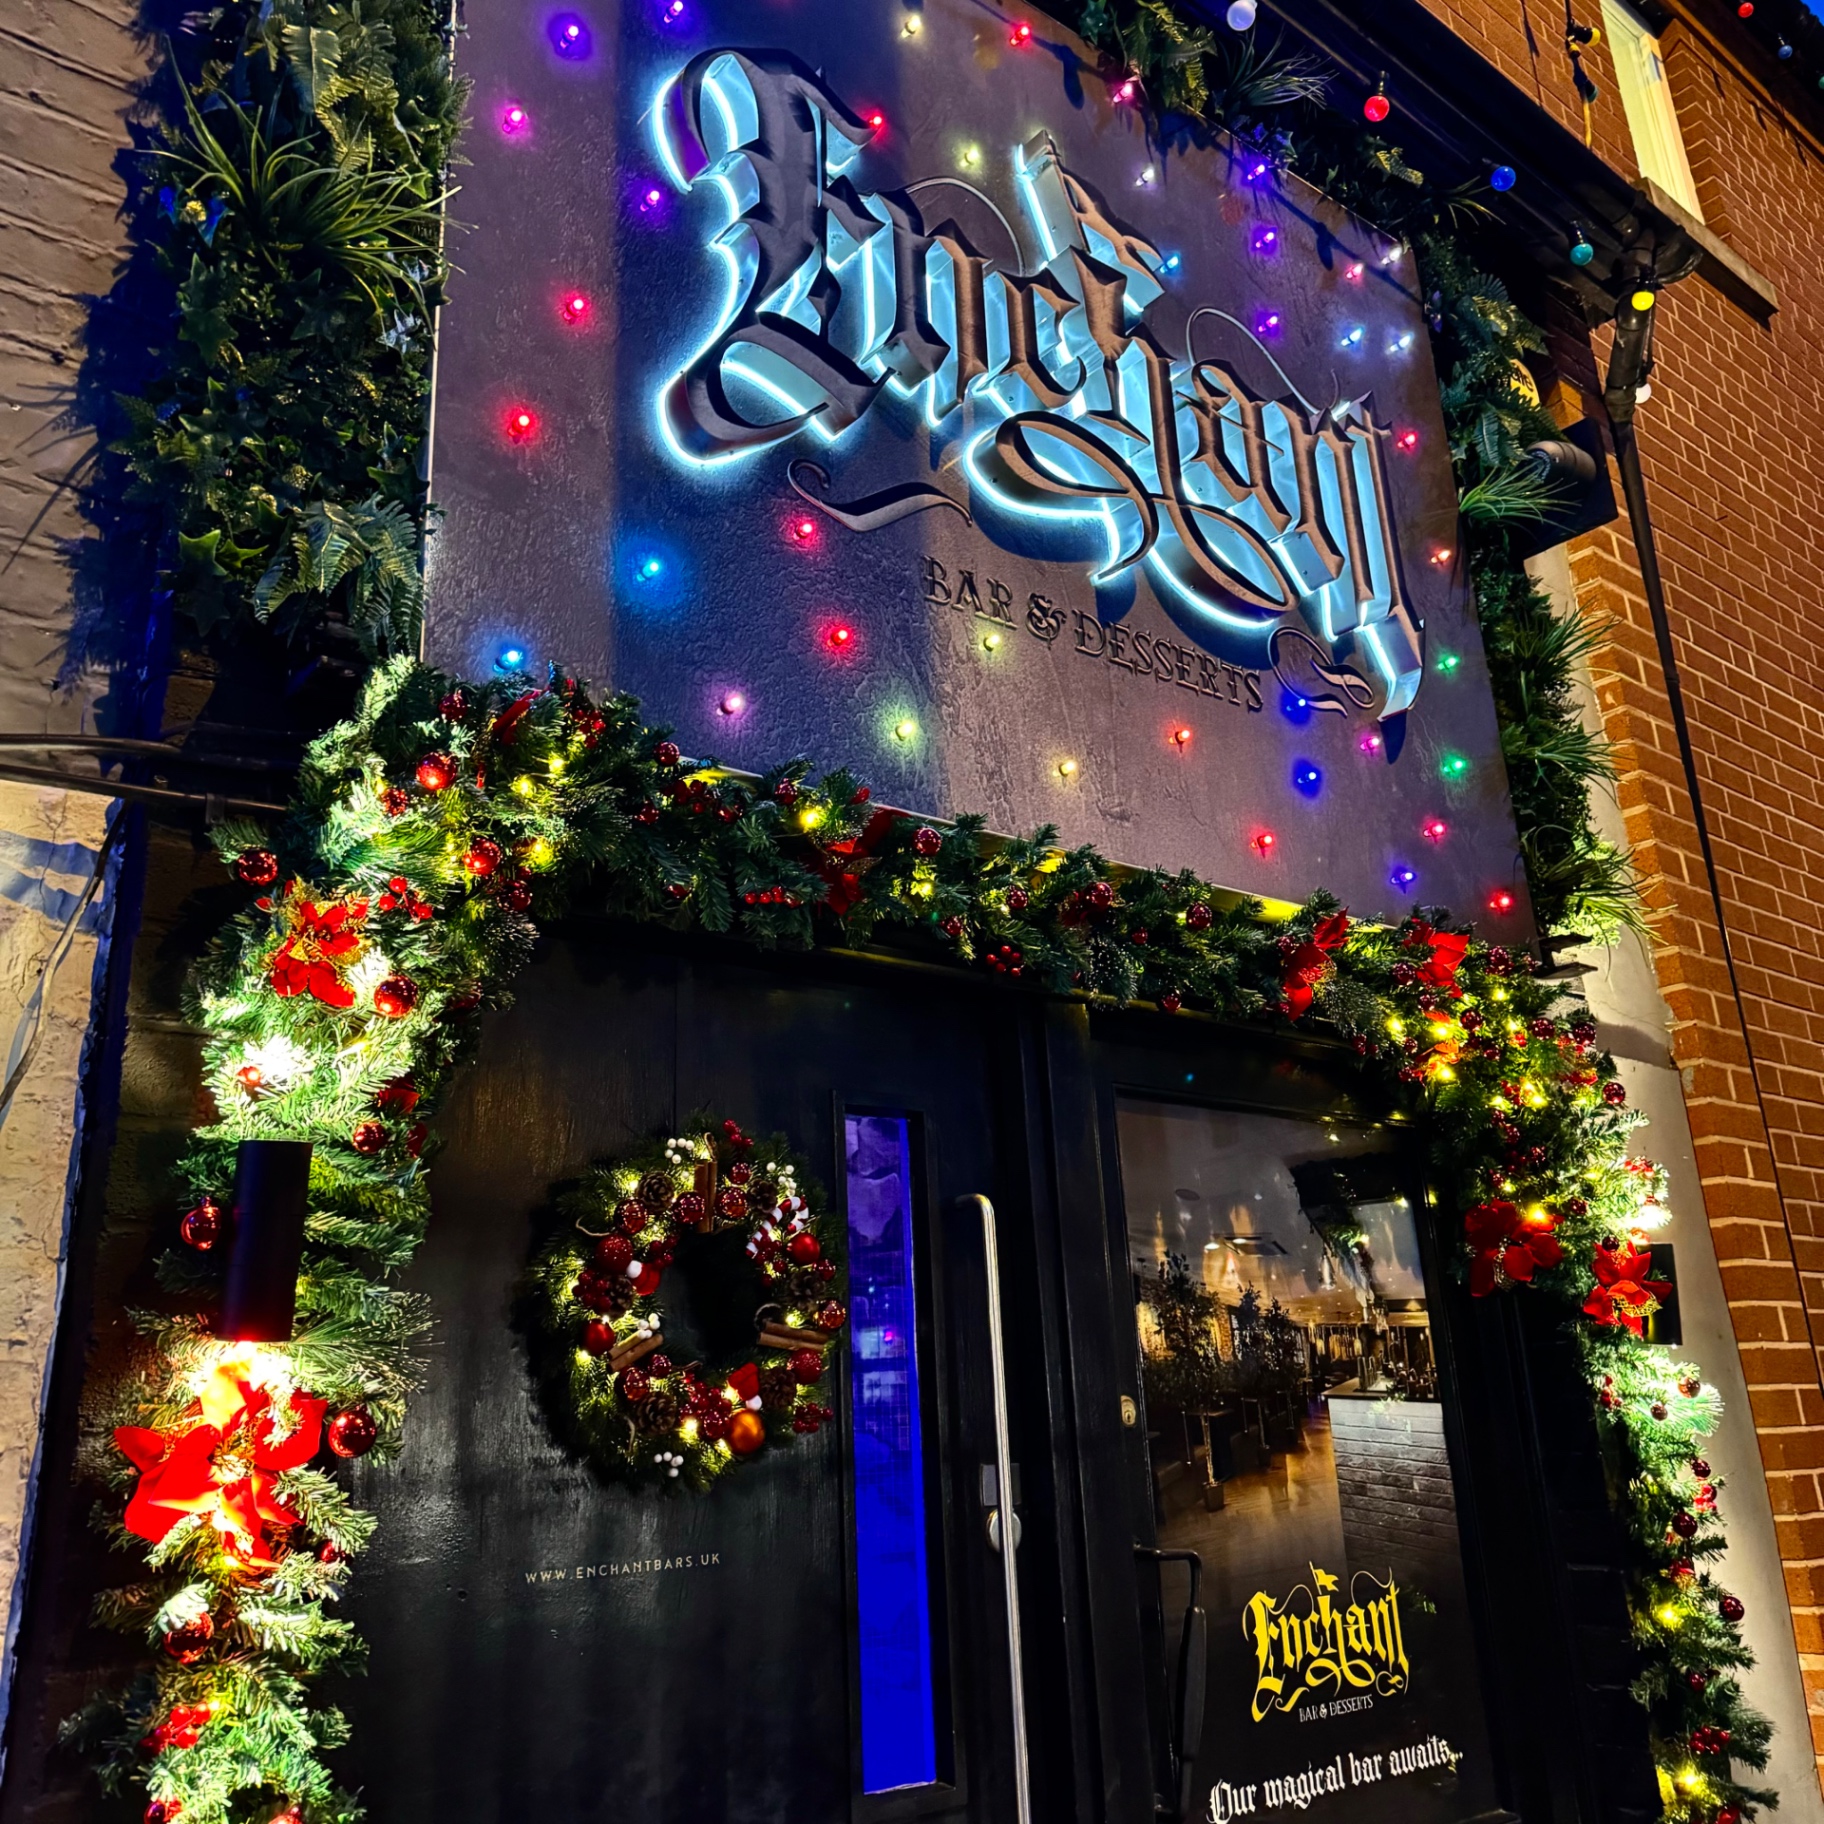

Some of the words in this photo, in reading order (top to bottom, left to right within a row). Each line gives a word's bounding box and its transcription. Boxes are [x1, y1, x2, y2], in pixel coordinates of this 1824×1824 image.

[653, 47, 1426, 720] Enchant
[924, 555, 1017, 629] BAR
[1025, 593, 1066, 641] &
[1072, 608, 1264, 711] DESSERTS
[525, 1553, 720, 1584] WWW.ENCHANTBARS.UK
[1242, 1560, 1410, 1722] Enchant
[1329, 1694, 1374, 1716] DESSERTS
[1206, 1778, 1257, 1824] Our
[1263, 1754, 1346, 1810] magical
[1348, 1751, 1383, 1786] bar
